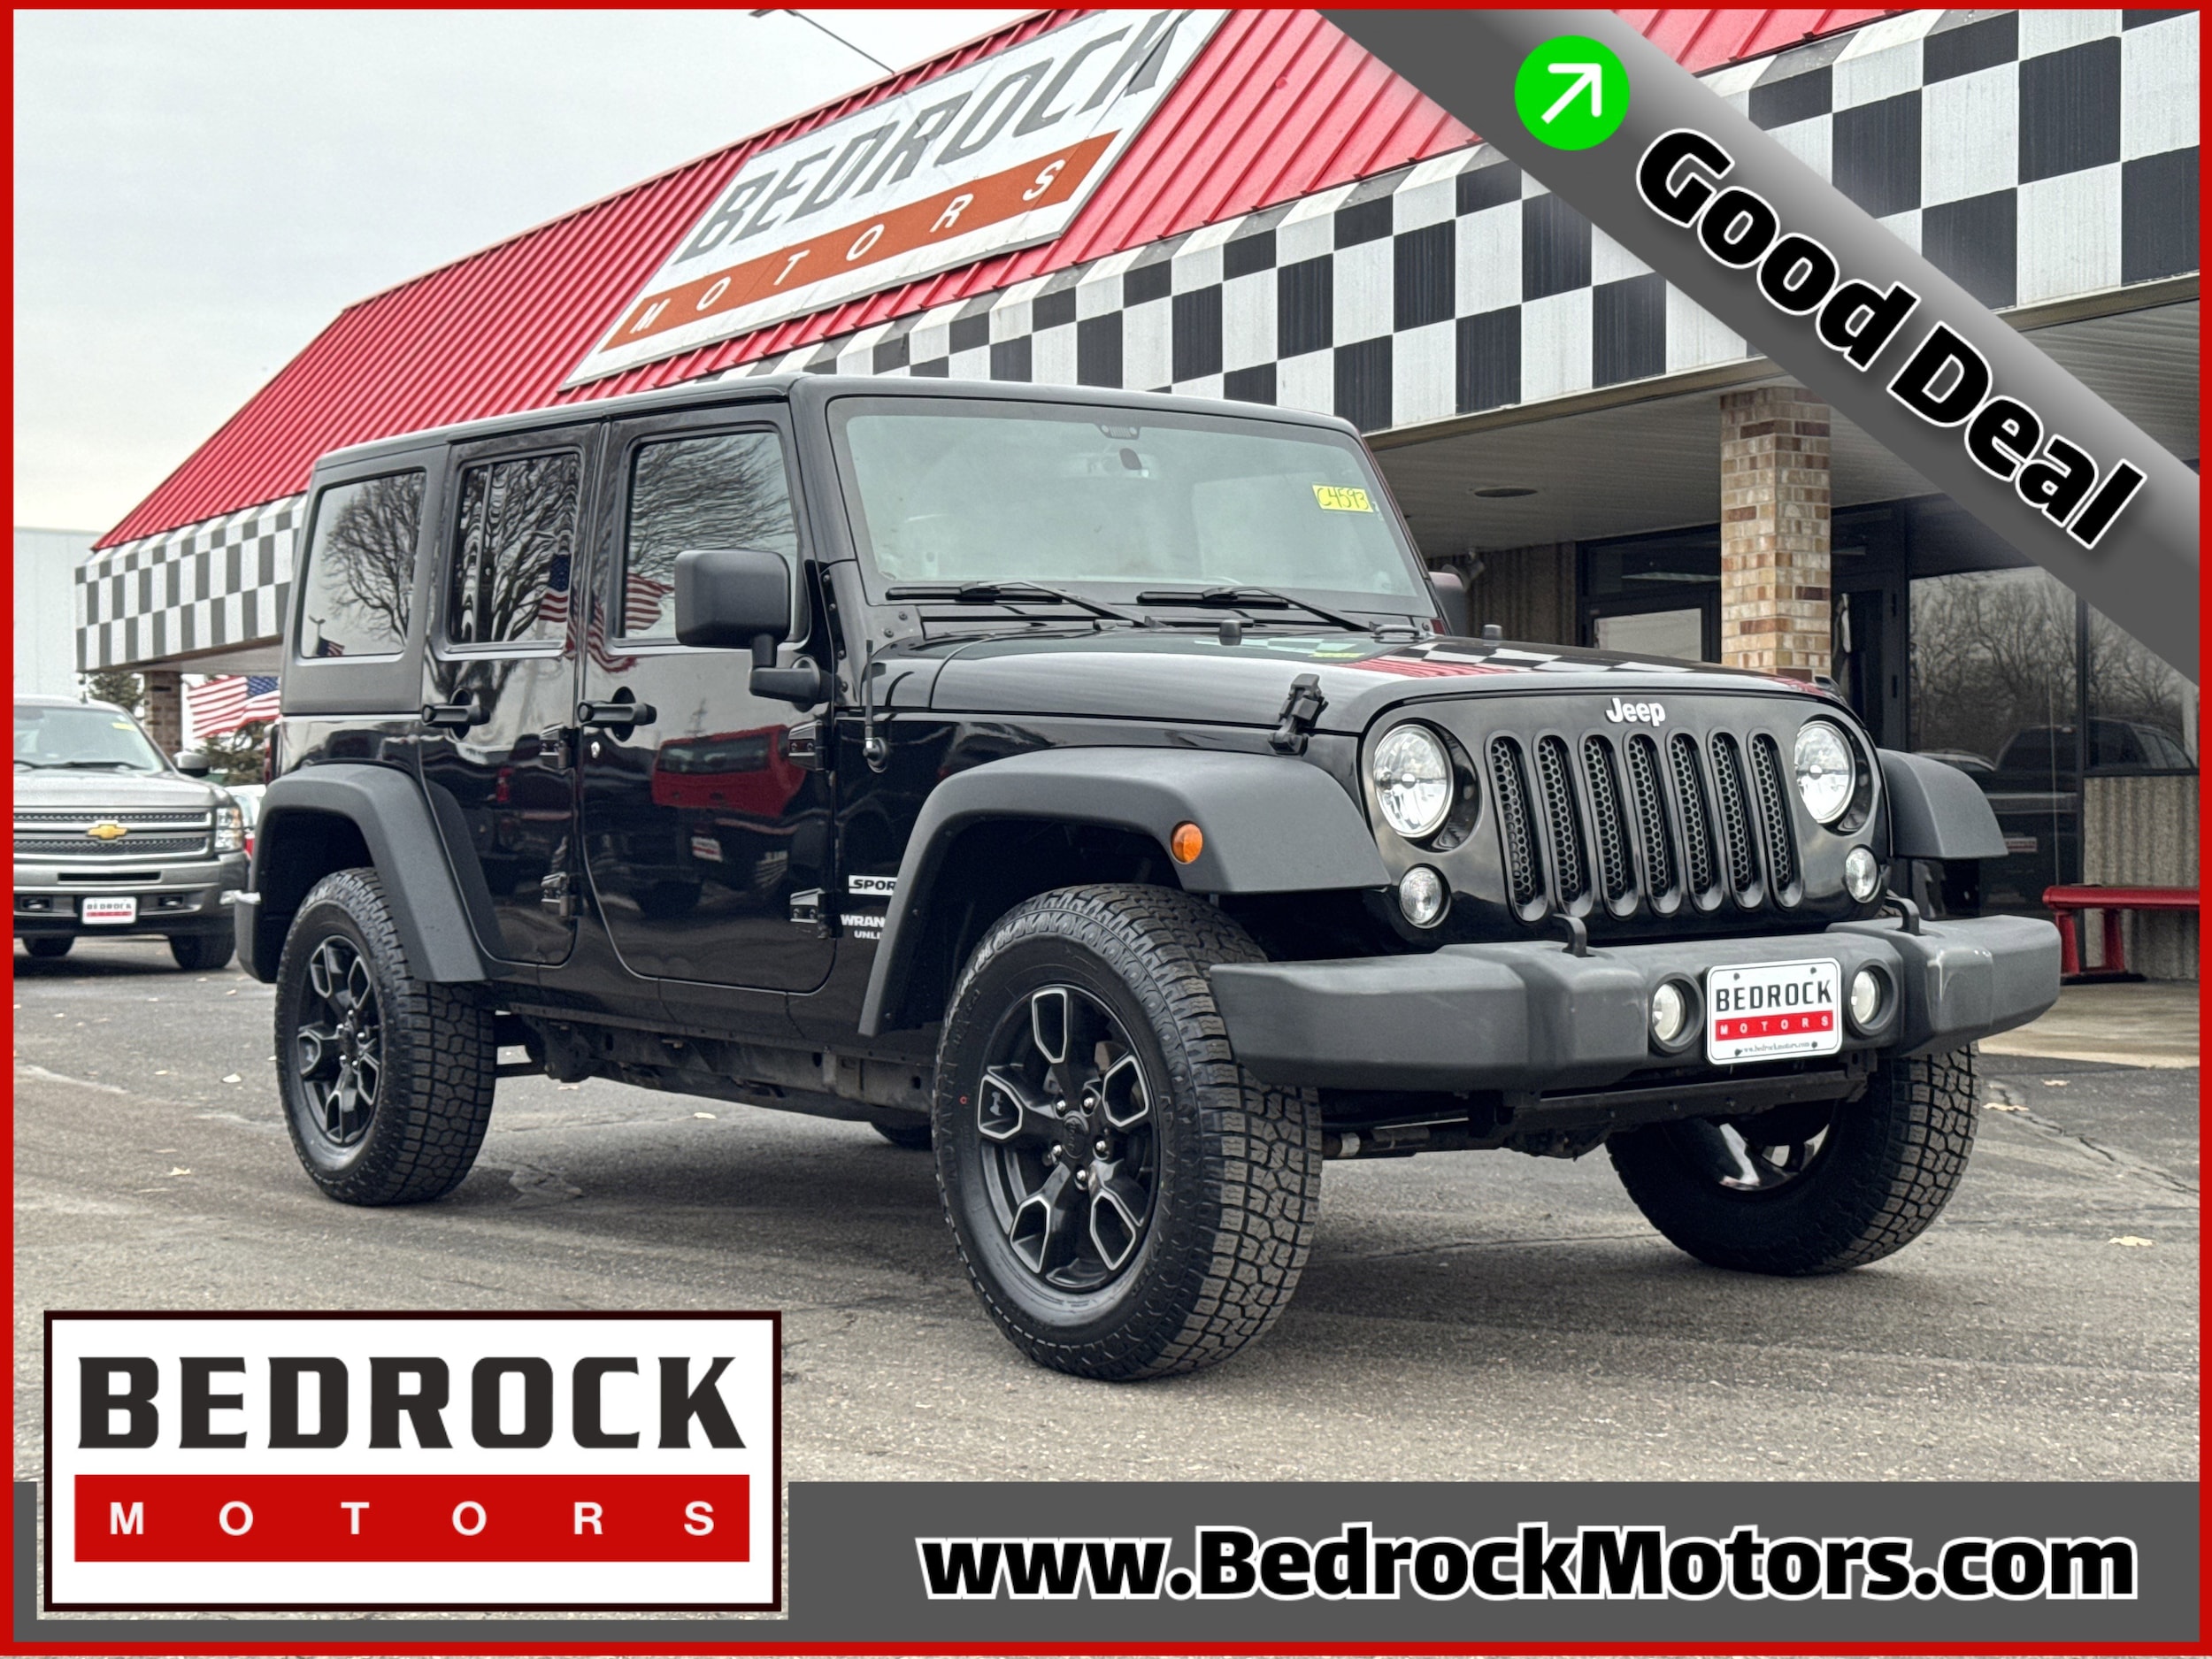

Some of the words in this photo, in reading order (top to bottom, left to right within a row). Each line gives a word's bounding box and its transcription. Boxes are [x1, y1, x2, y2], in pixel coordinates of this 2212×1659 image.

[671, 10, 1195, 265] BEDROCK
[629, 159, 1065, 334] MOTORS
[1317, 487, 1369, 510] C4593
[1605, 697, 1666, 727] Jeep
[849, 879, 896, 891] SPOR
[840, 914, 886, 928] WRAN
[854, 930, 881, 940] UNLI
[1715, 979, 1832, 1013] BEDROCK
[1719, 1015, 1829, 1035] MOTORS
